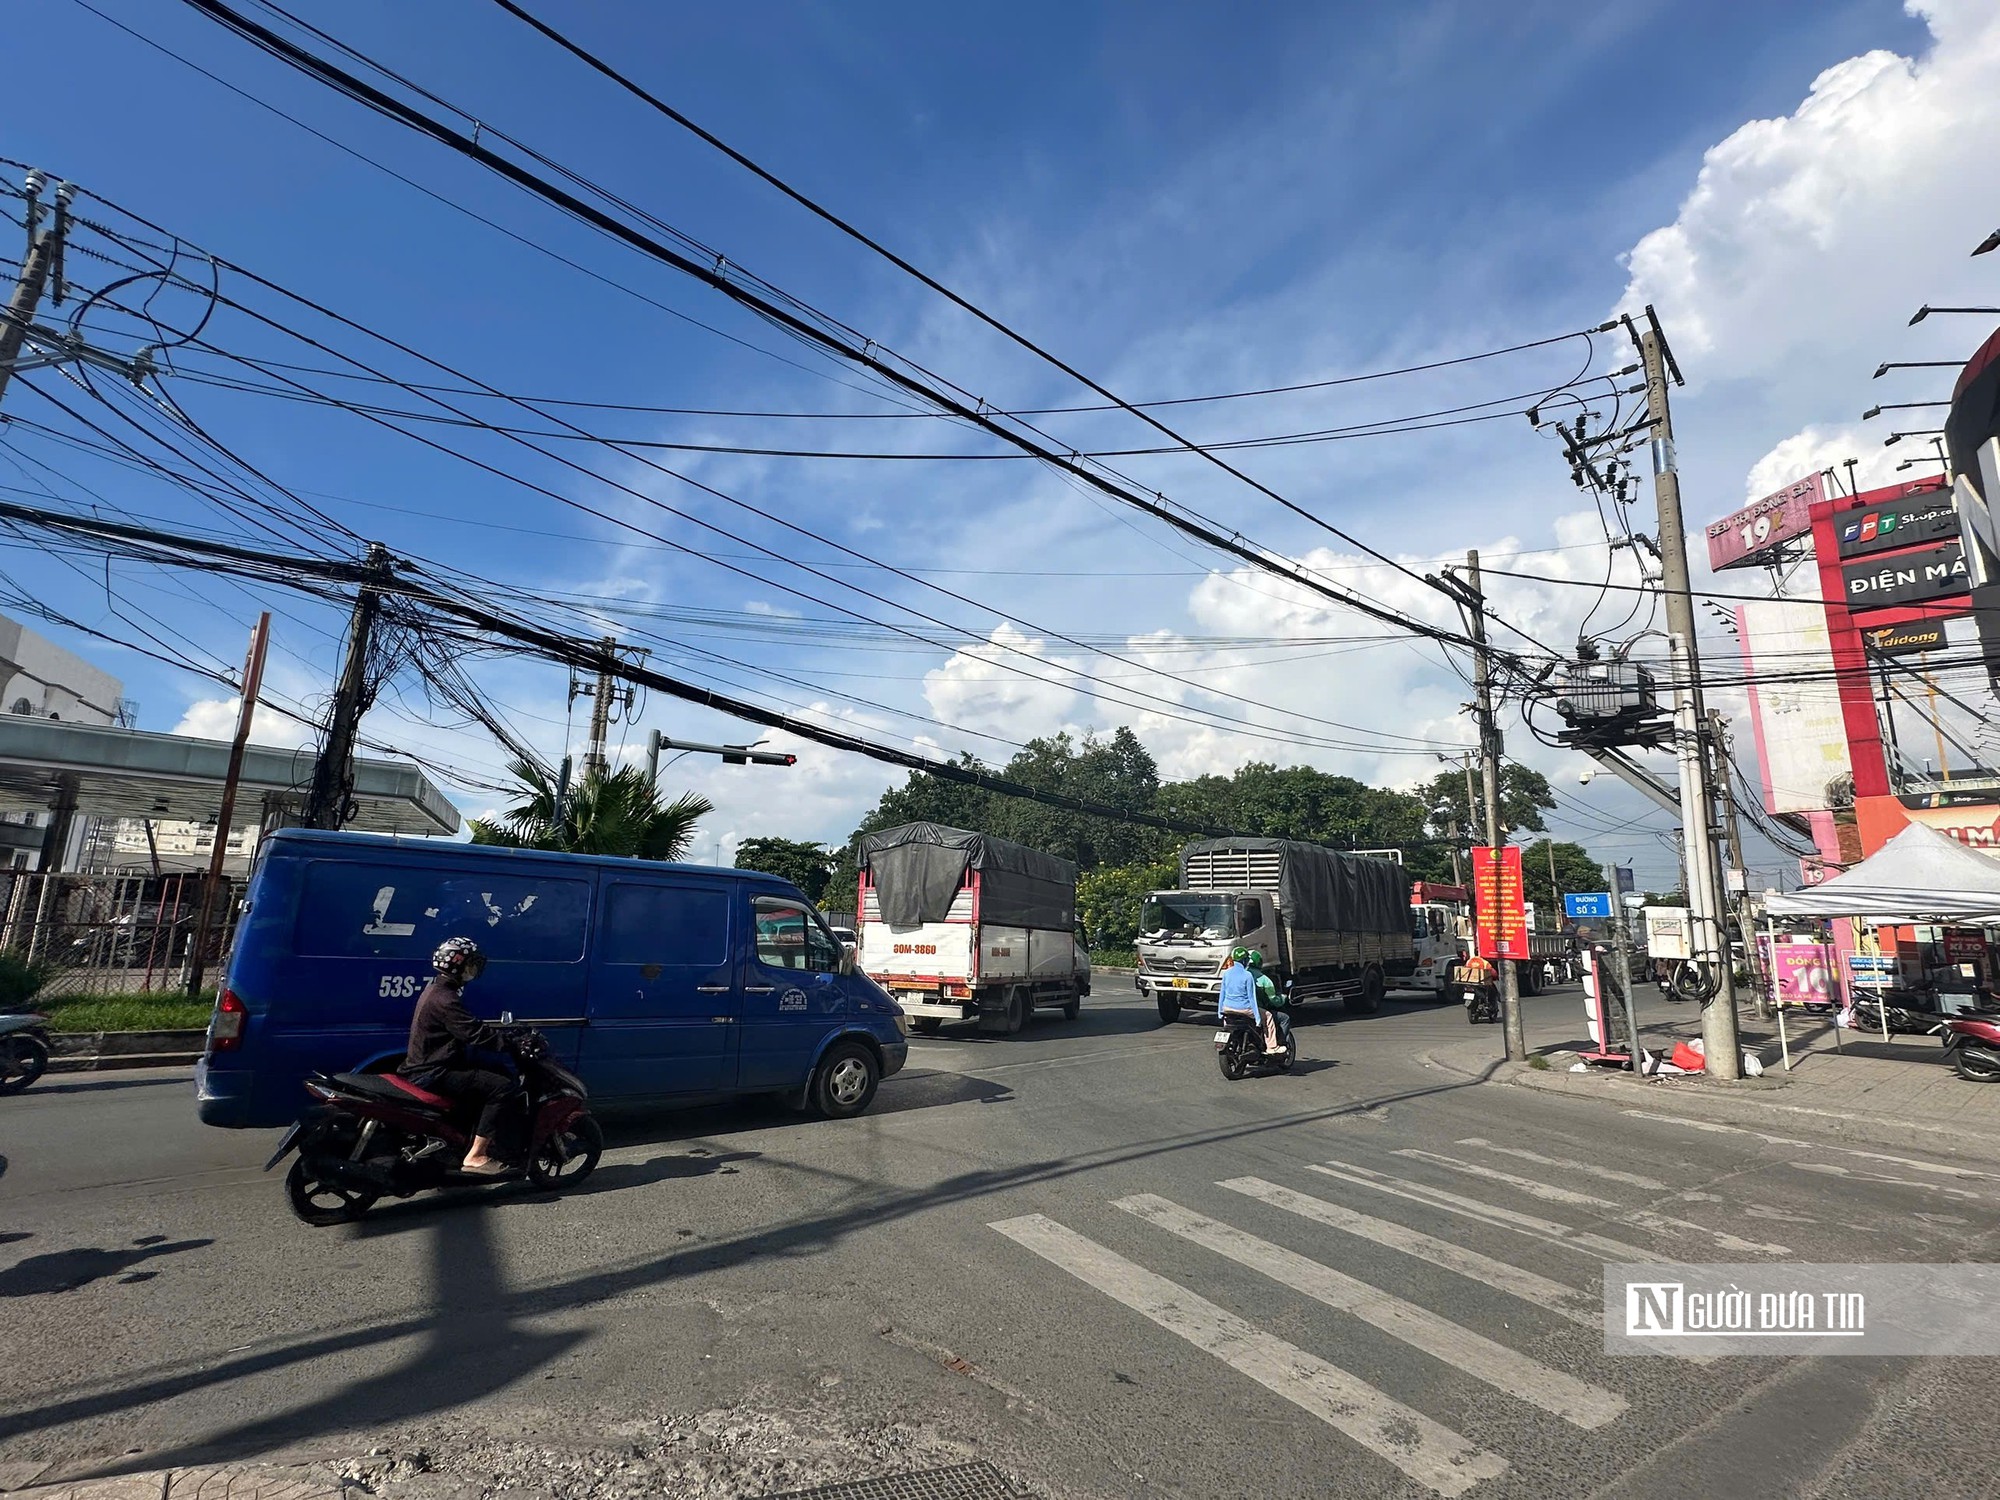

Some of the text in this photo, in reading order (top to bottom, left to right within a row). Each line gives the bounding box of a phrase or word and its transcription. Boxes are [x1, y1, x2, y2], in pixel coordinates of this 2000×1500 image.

[1844, 515, 1896, 540] FPT
[1850, 569, 1916, 594] ĐIỆN
[1576, 904, 1597, 914] SỐ 3
